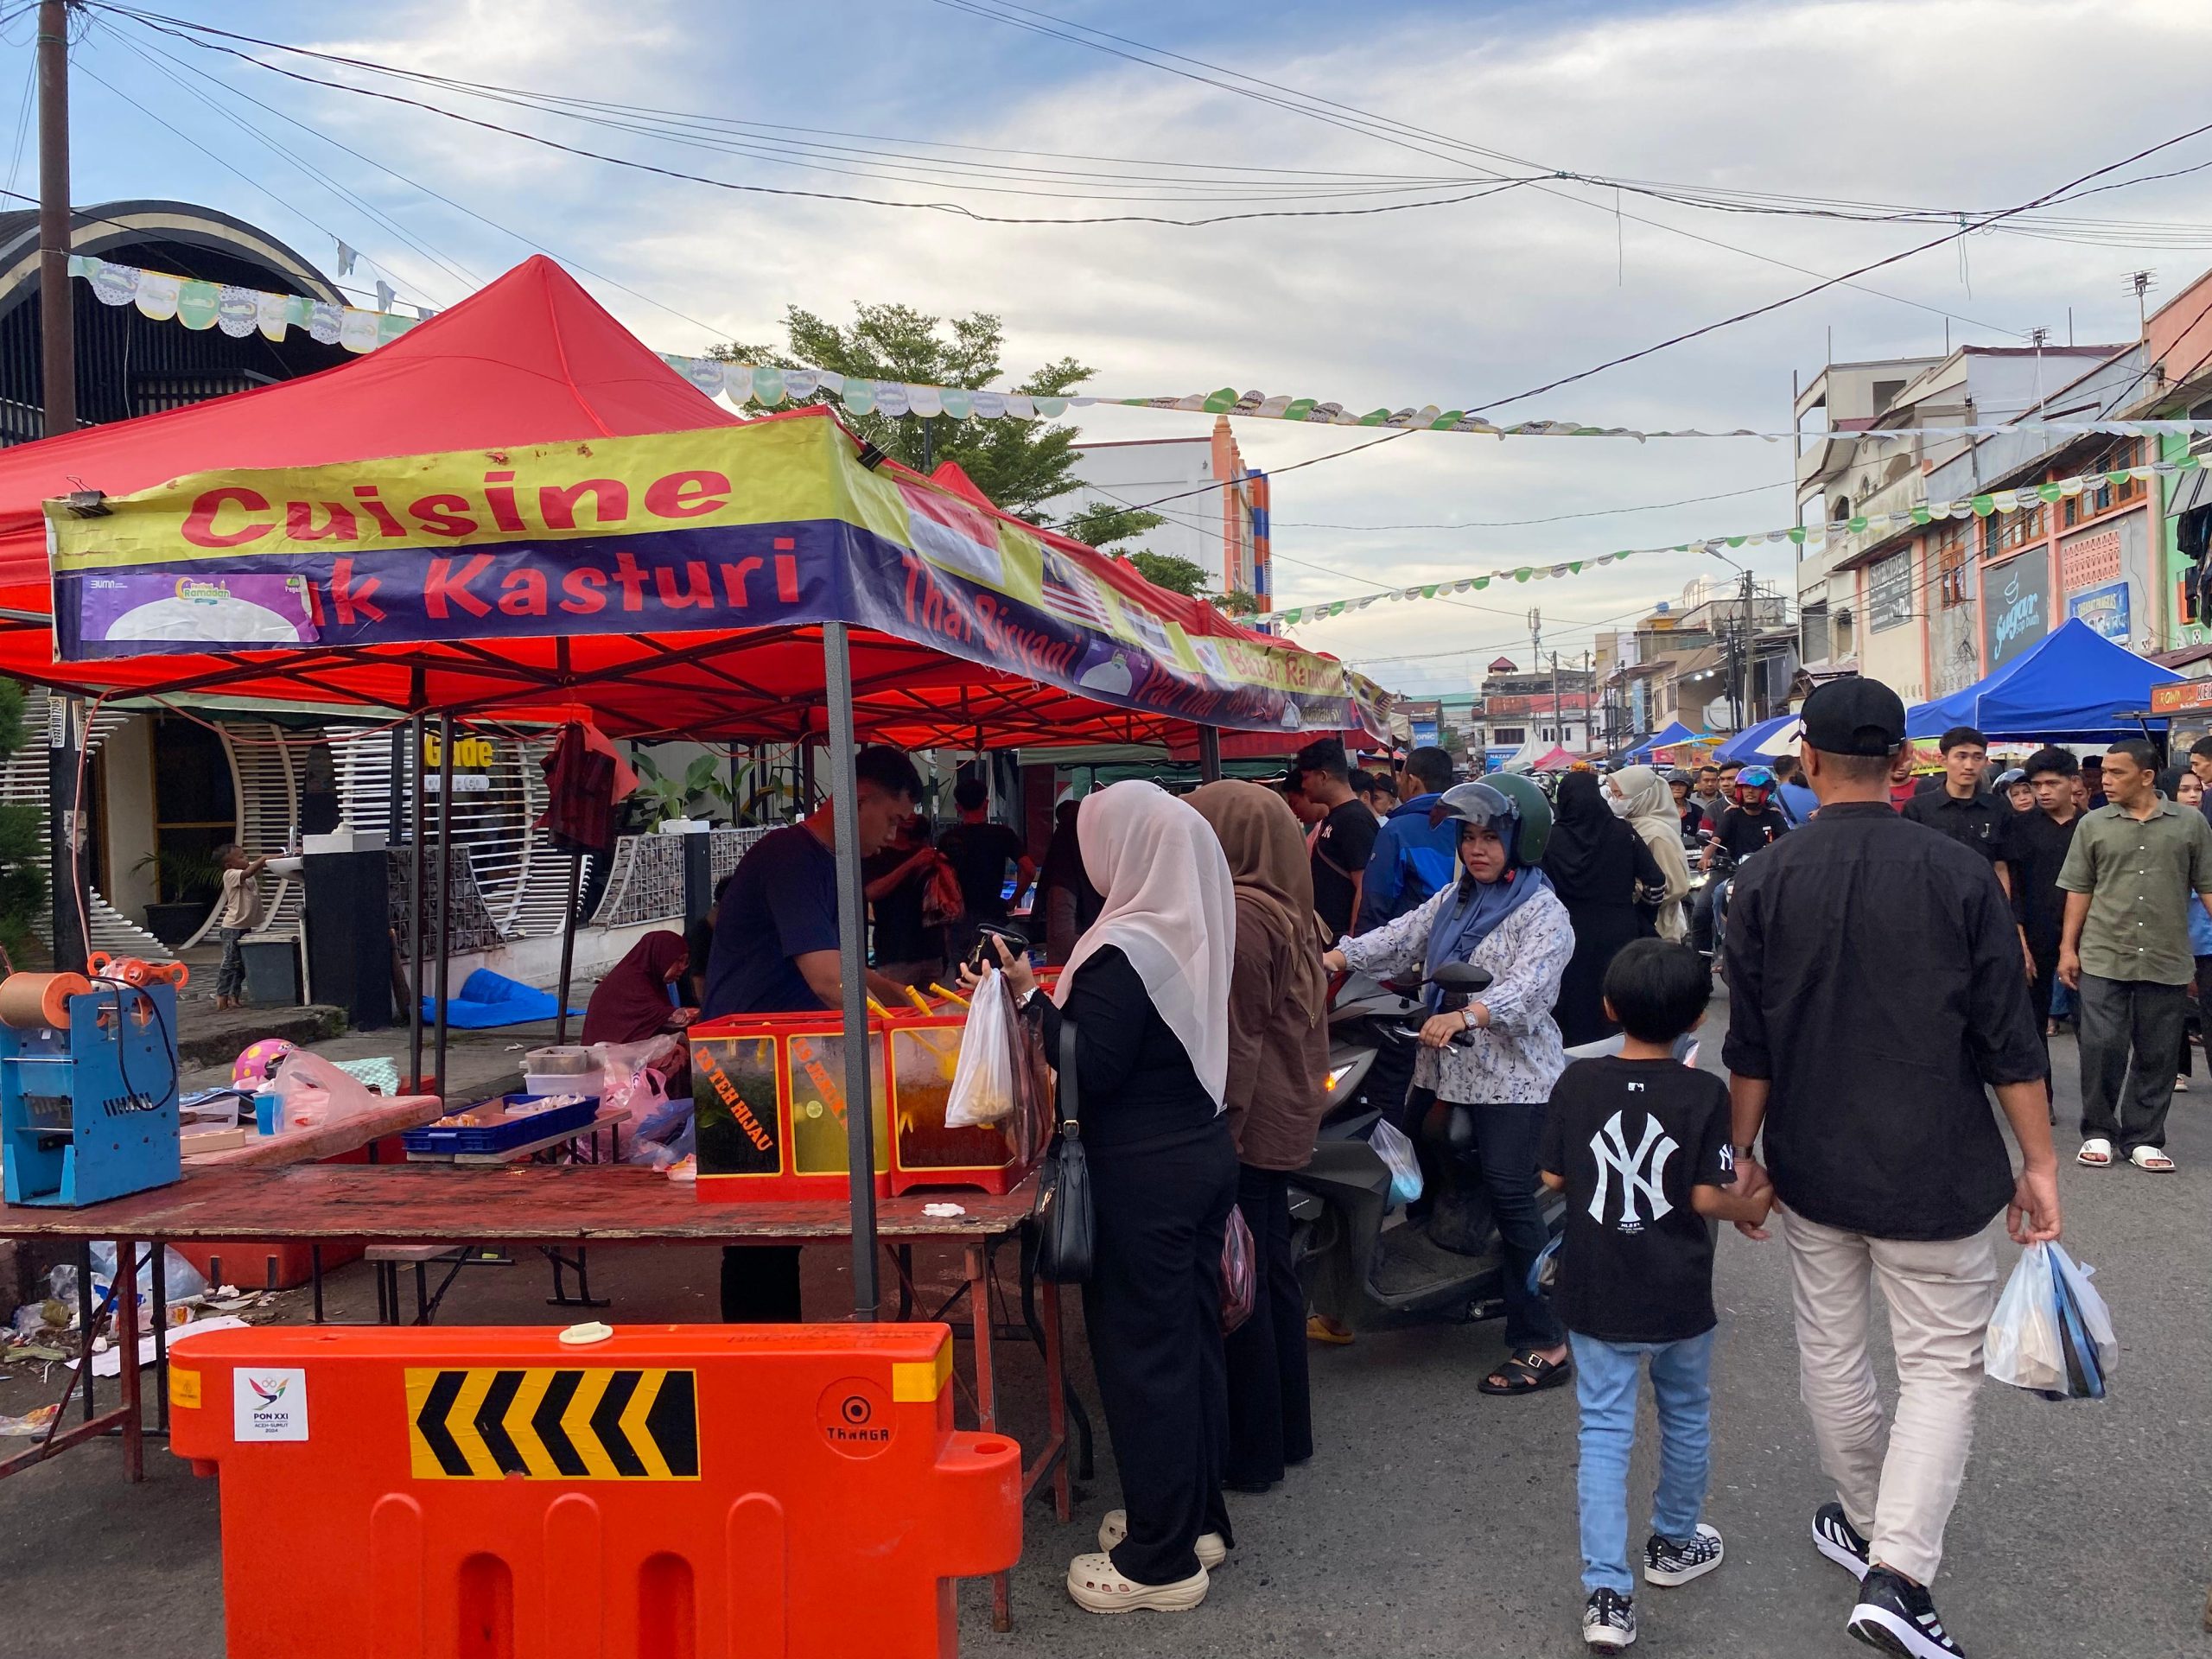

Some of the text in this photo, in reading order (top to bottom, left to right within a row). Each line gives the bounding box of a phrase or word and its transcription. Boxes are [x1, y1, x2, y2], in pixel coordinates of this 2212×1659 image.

[181, 470, 732, 548] Cuisine
[184, 589, 229, 598] Ramadan
[423, 537, 799, 619] Kasturi
[901, 553, 1082, 678] Thai Biryani
[1134, 659, 1188, 708] Pad
[709, 1067, 773, 1151] TEH HIJAU
